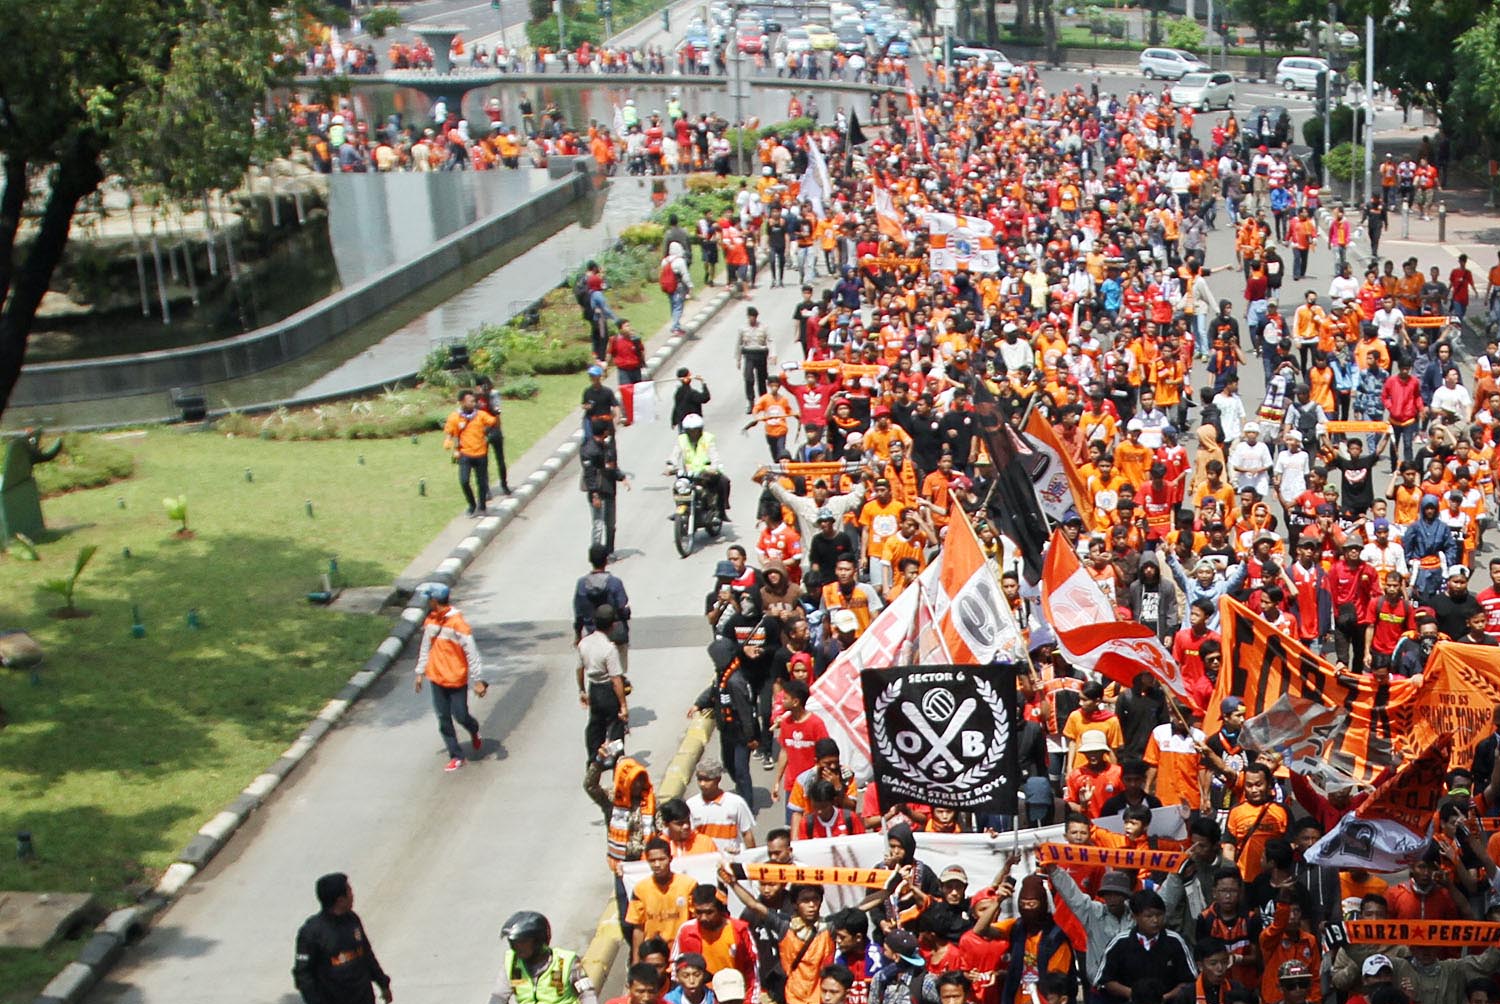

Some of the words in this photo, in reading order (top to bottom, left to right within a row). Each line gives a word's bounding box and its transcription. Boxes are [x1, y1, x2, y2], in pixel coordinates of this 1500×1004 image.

[907, 672, 953, 684] SECTOR
[956, 671, 966, 682] 6
[881, 773, 926, 795] ORANGE
[927, 788, 972, 801] STREET
[973, 774, 1008, 796] BOYS
[1099, 848, 1184, 869] VIKING
[758, 866, 880, 884] PERSIJA
[1352, 924, 1409, 940] FORZA
